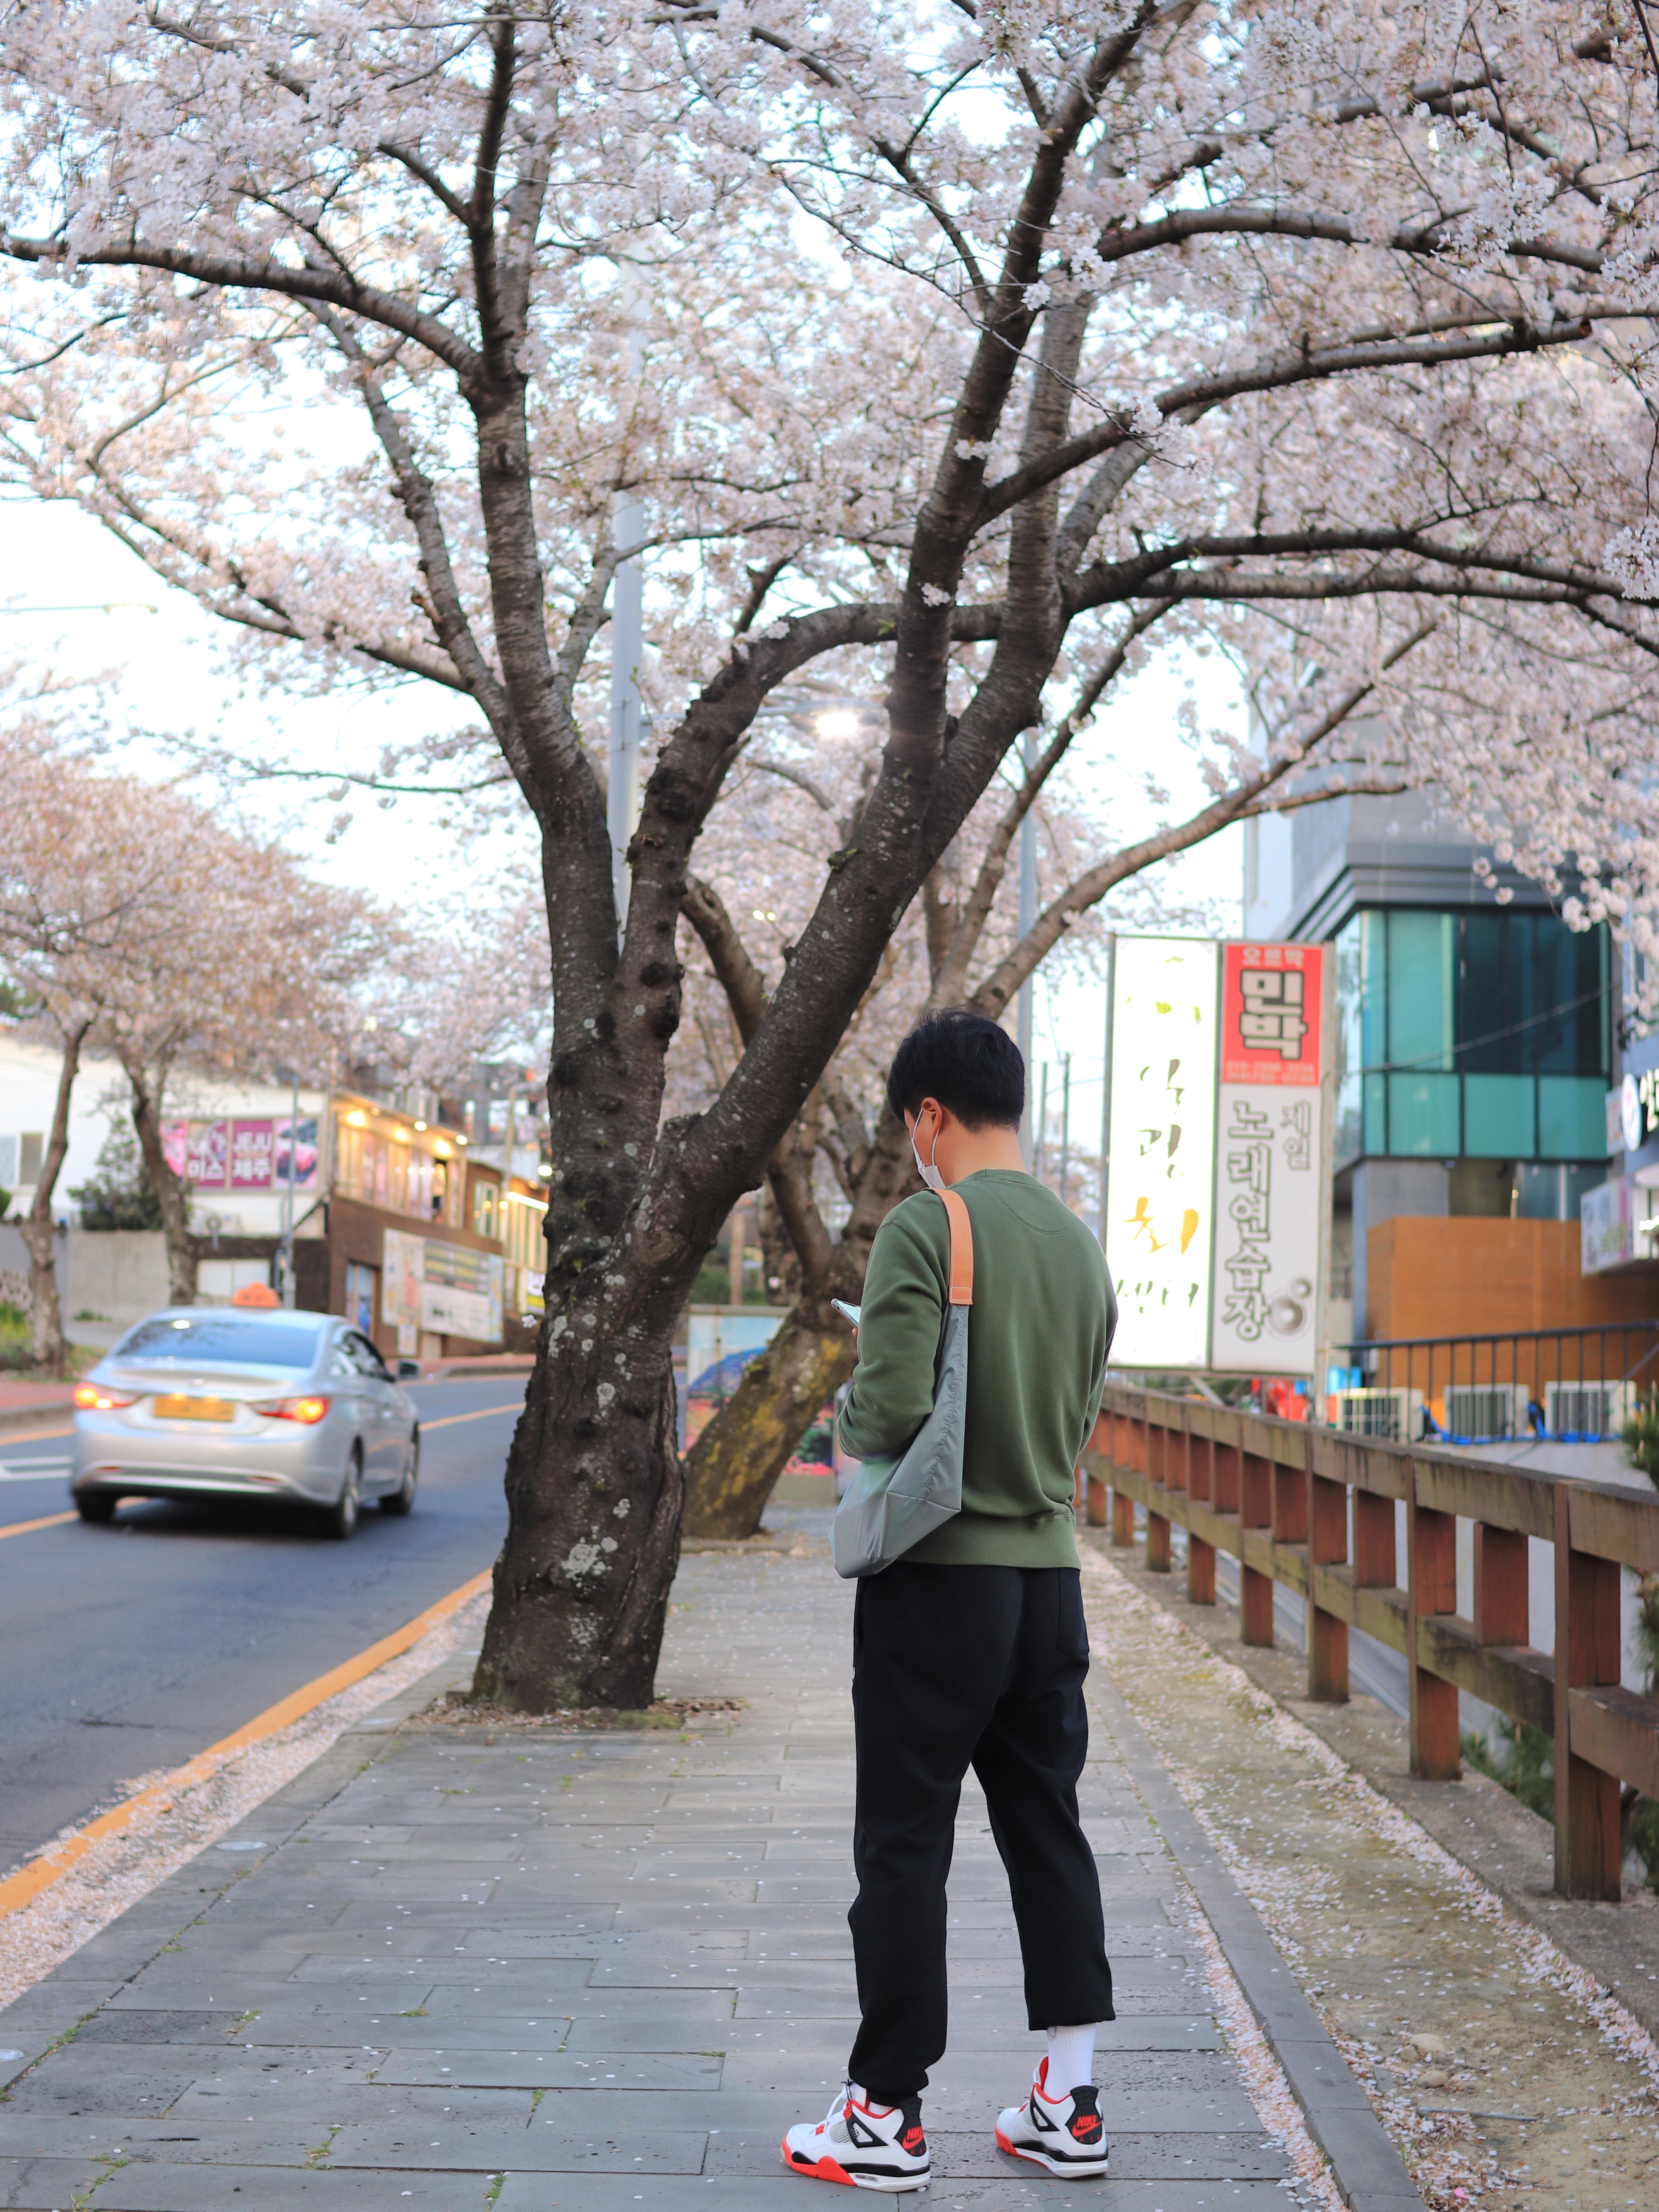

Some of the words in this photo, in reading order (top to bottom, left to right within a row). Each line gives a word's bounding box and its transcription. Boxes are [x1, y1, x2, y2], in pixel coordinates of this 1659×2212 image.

[1240, 969, 1309, 1060] 민박
[234, 1131, 272, 1154] JEJU
[1280, 1100, 1311, 1171] 제일
[233, 1157, 270, 1181] 제주
[1221, 1101, 1274, 1341] 노래연습장
[1076, 2115, 1097, 2127] NIKE
